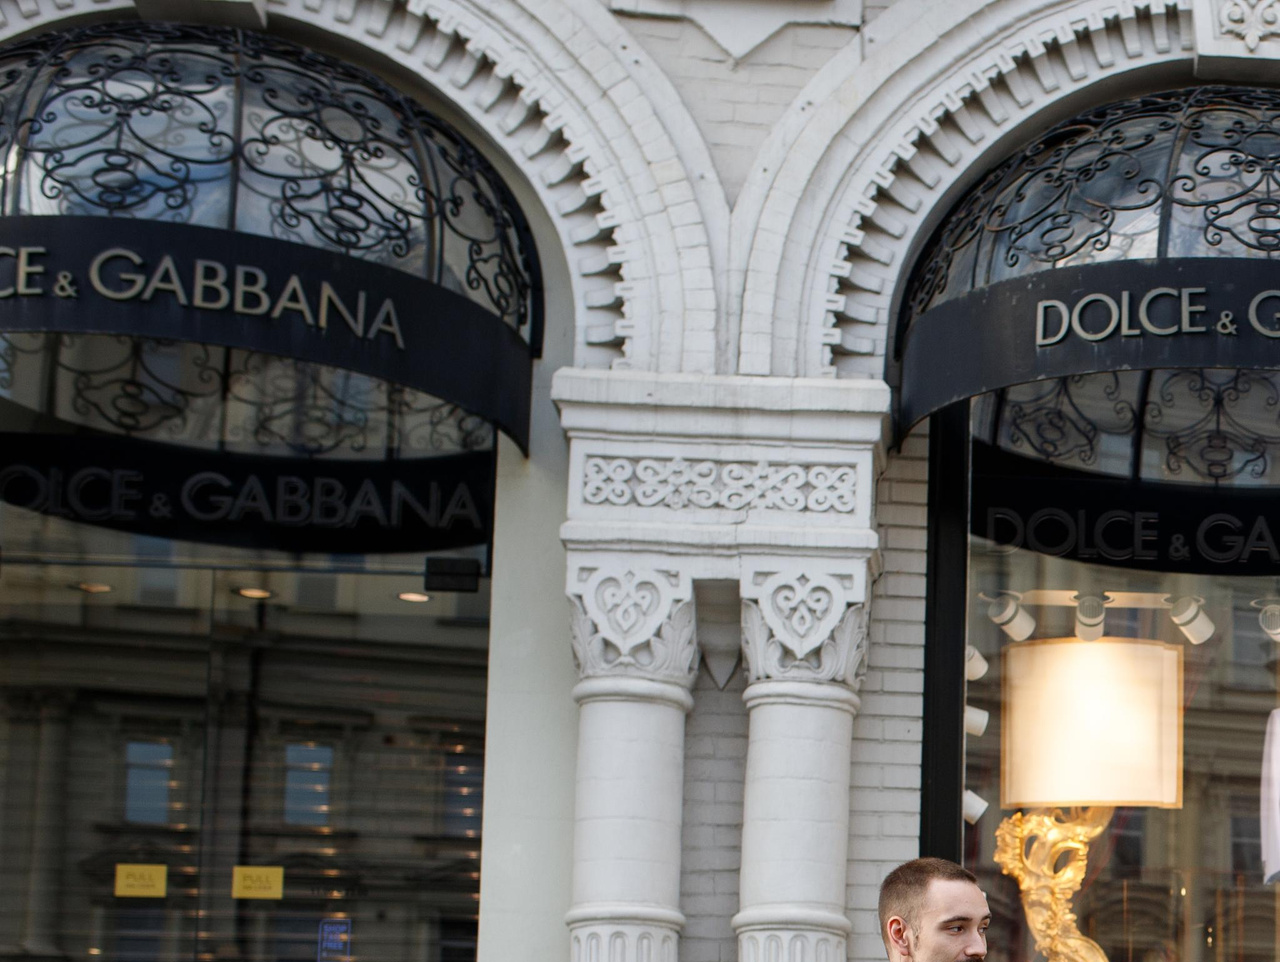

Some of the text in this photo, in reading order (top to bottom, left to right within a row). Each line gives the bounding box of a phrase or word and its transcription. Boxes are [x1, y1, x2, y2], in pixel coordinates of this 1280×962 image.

[53, 270, 78, 297] &
[89, 248, 405, 350] GABBANA
[1036, 287, 1206, 346] DOLCE
[1216, 310, 1237, 335] &
[148, 492, 173, 518] &
[181, 471, 483, 530] GABBANA
[986, 506, 1160, 560] DOLCE
[1168, 534, 1191, 561] &
[126, 872, 154, 883] PULL
[242, 873, 272, 884] PULL
